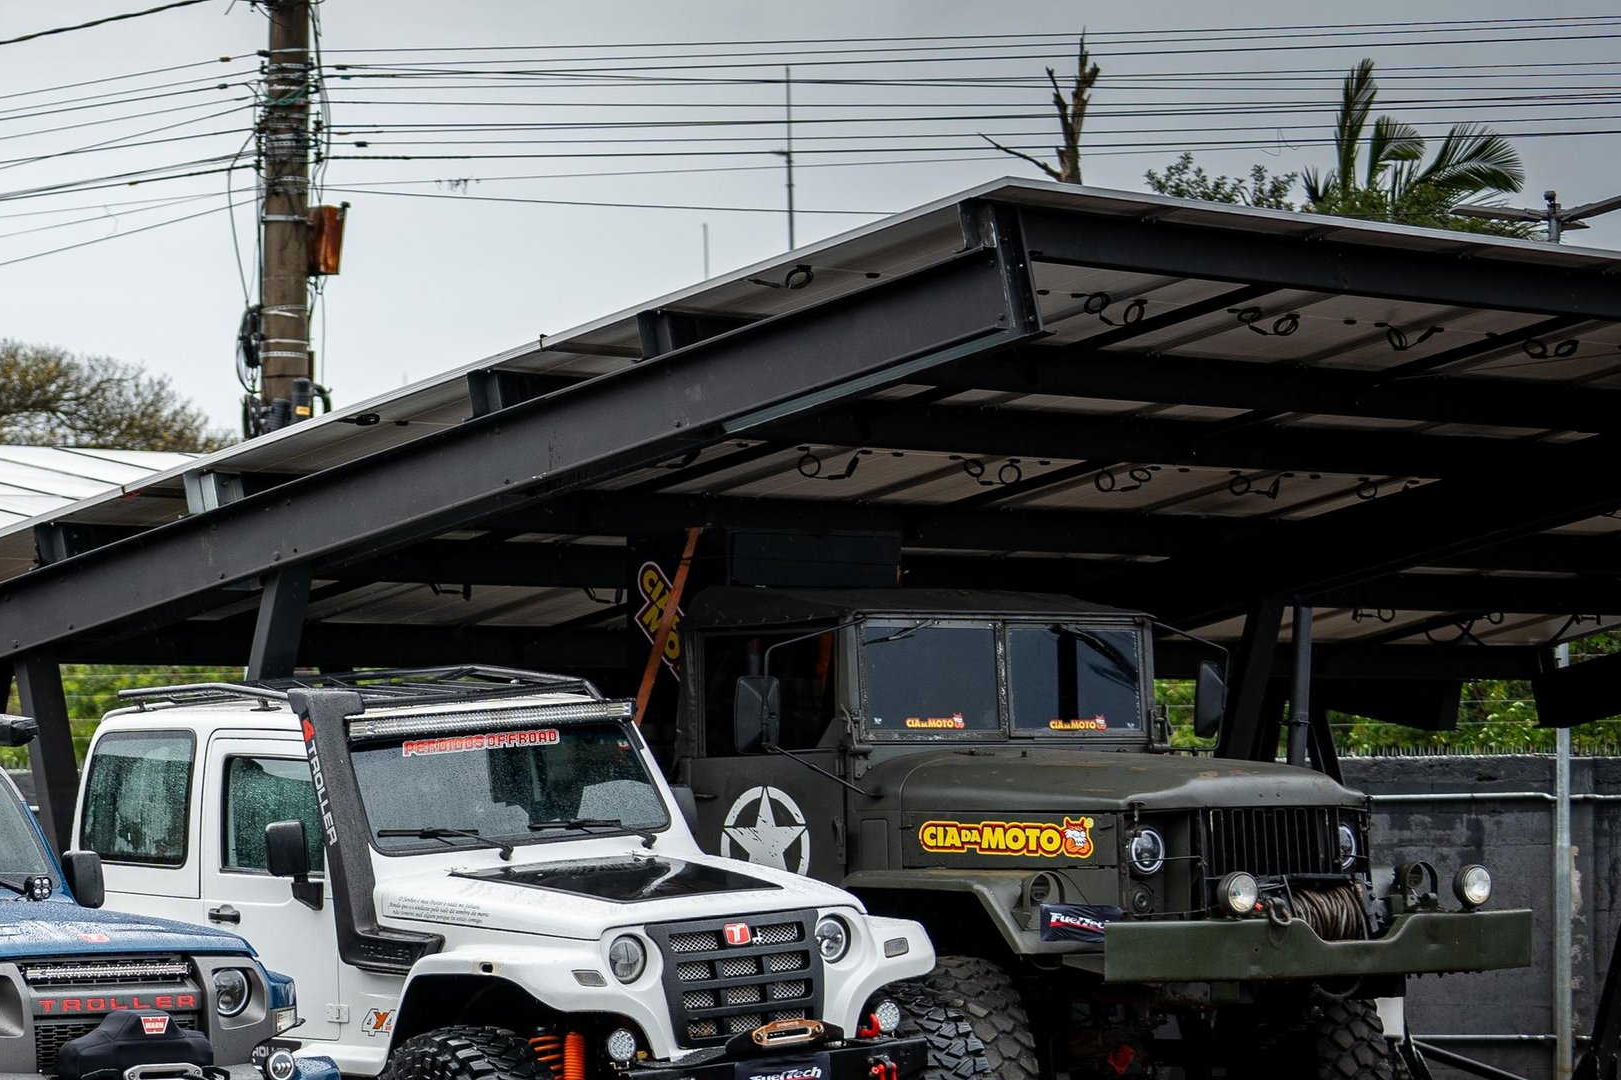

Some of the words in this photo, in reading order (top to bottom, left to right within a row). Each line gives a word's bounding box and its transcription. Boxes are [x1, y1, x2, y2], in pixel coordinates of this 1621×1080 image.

[403, 736, 484, 757] PERDIDOS
[485, 729, 559, 748] OFFROAD
[308, 740, 339, 846] TROLLER
[923, 826, 962, 847] CIA
[981, 827, 1061, 851] MOTO
[1050, 912, 1105, 929] FuelTec
[38, 994, 196, 1013] TROLLER
